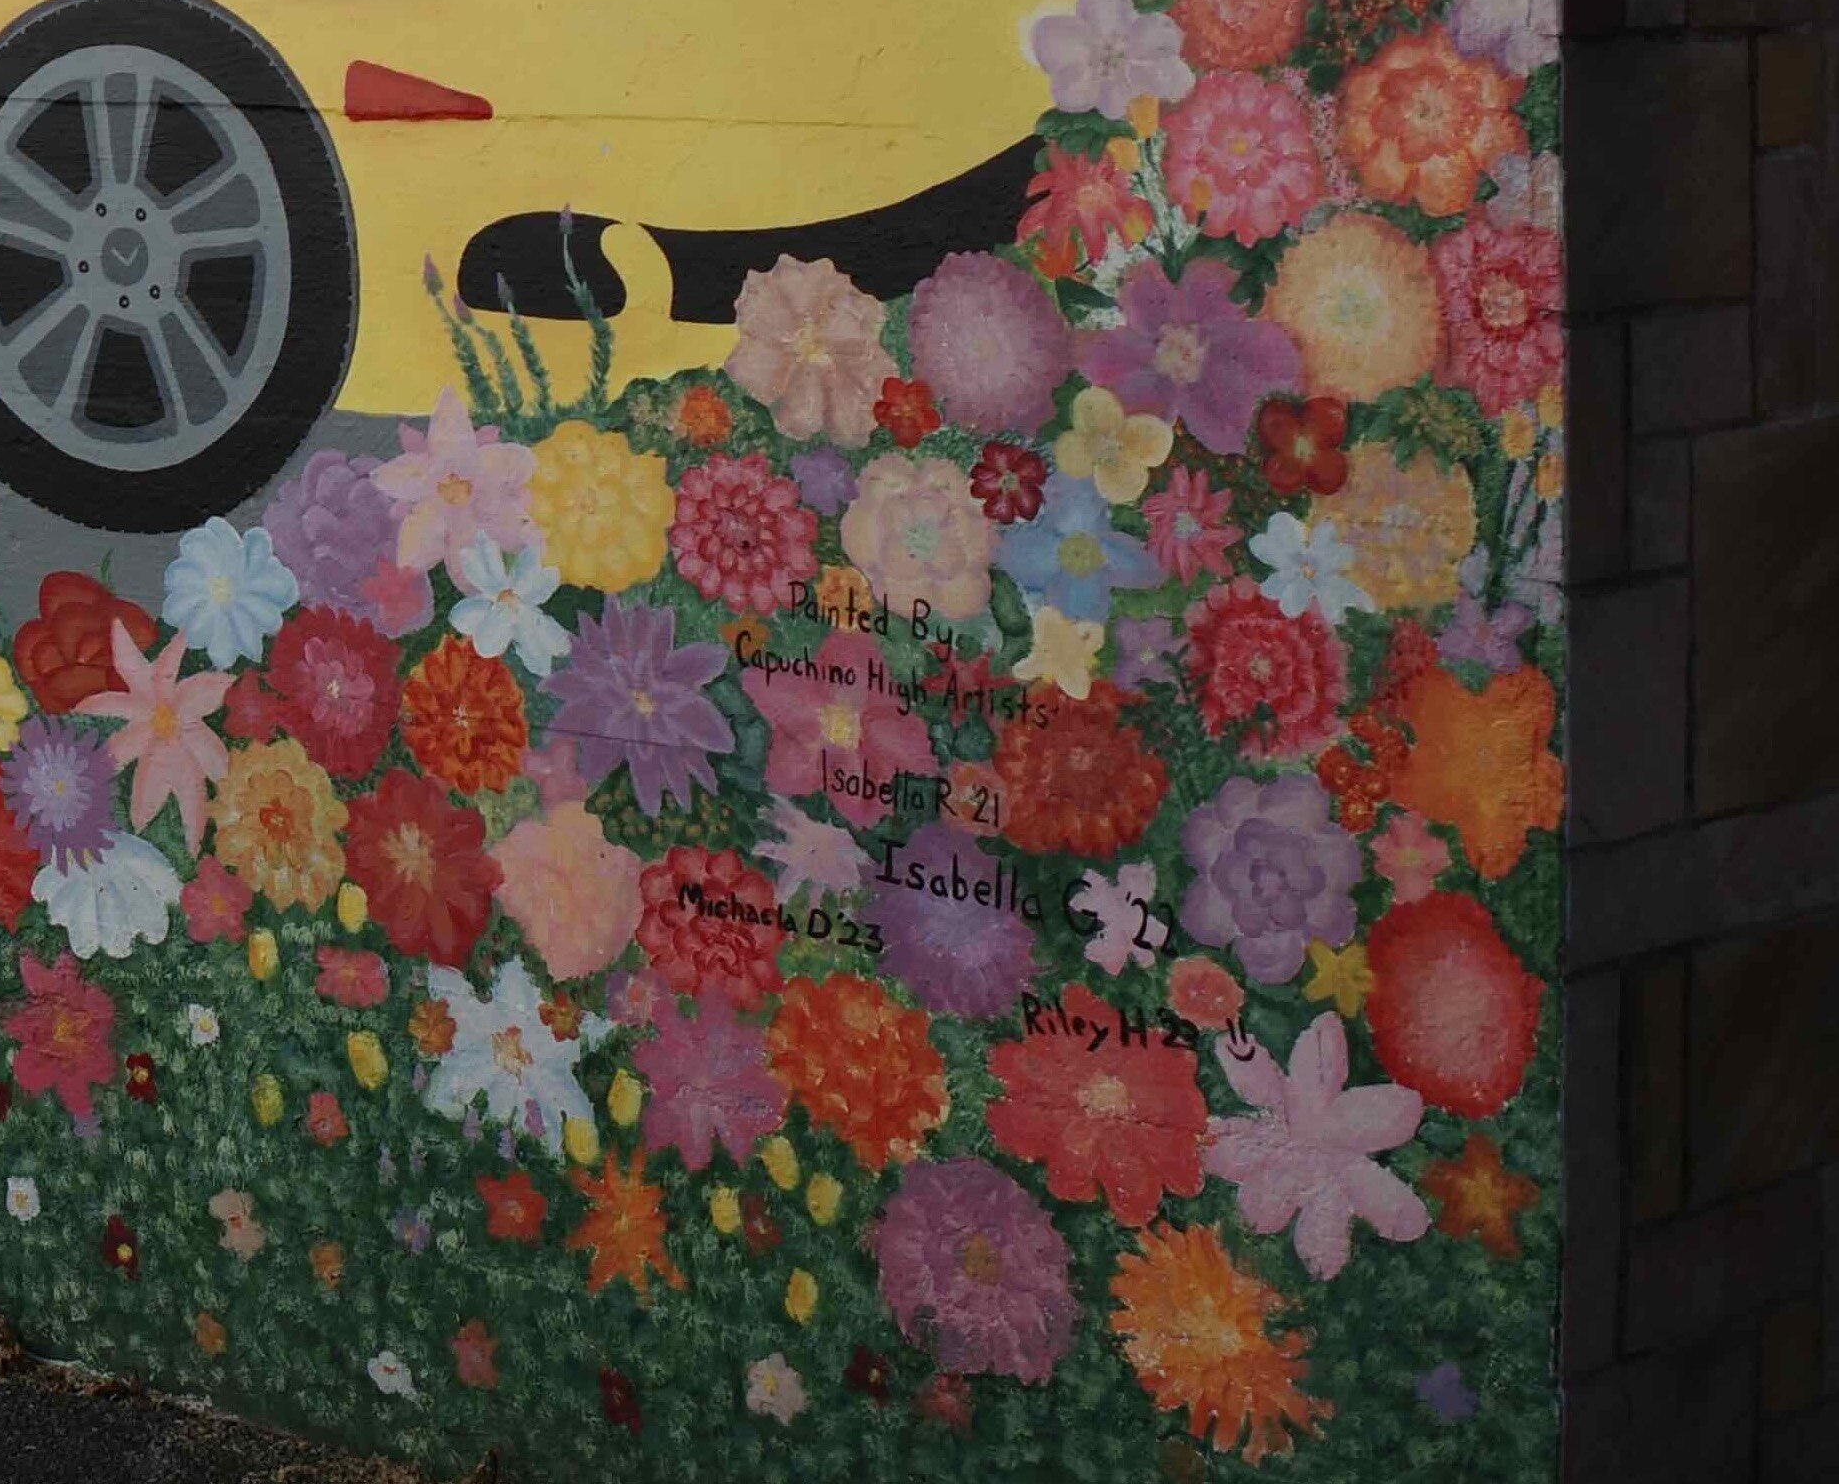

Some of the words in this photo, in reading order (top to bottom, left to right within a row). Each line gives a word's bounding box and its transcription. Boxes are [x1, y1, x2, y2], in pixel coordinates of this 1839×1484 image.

[788, 580, 889, 636] Painted
[911, 597, 954, 663] By
[735, 630, 857, 688] Capuchino
[867, 657, 927, 716] High
[821, 748, 926, 811] Isabella
[935, 777, 958, 817] R
[677, 882, 798, 934] Michaela
[806, 908, 833, 939] D
[875, 838, 1044, 923] Isabella
[1021, 991, 1110, 1052] Riley
[1119, 1006, 1148, 1049] H
